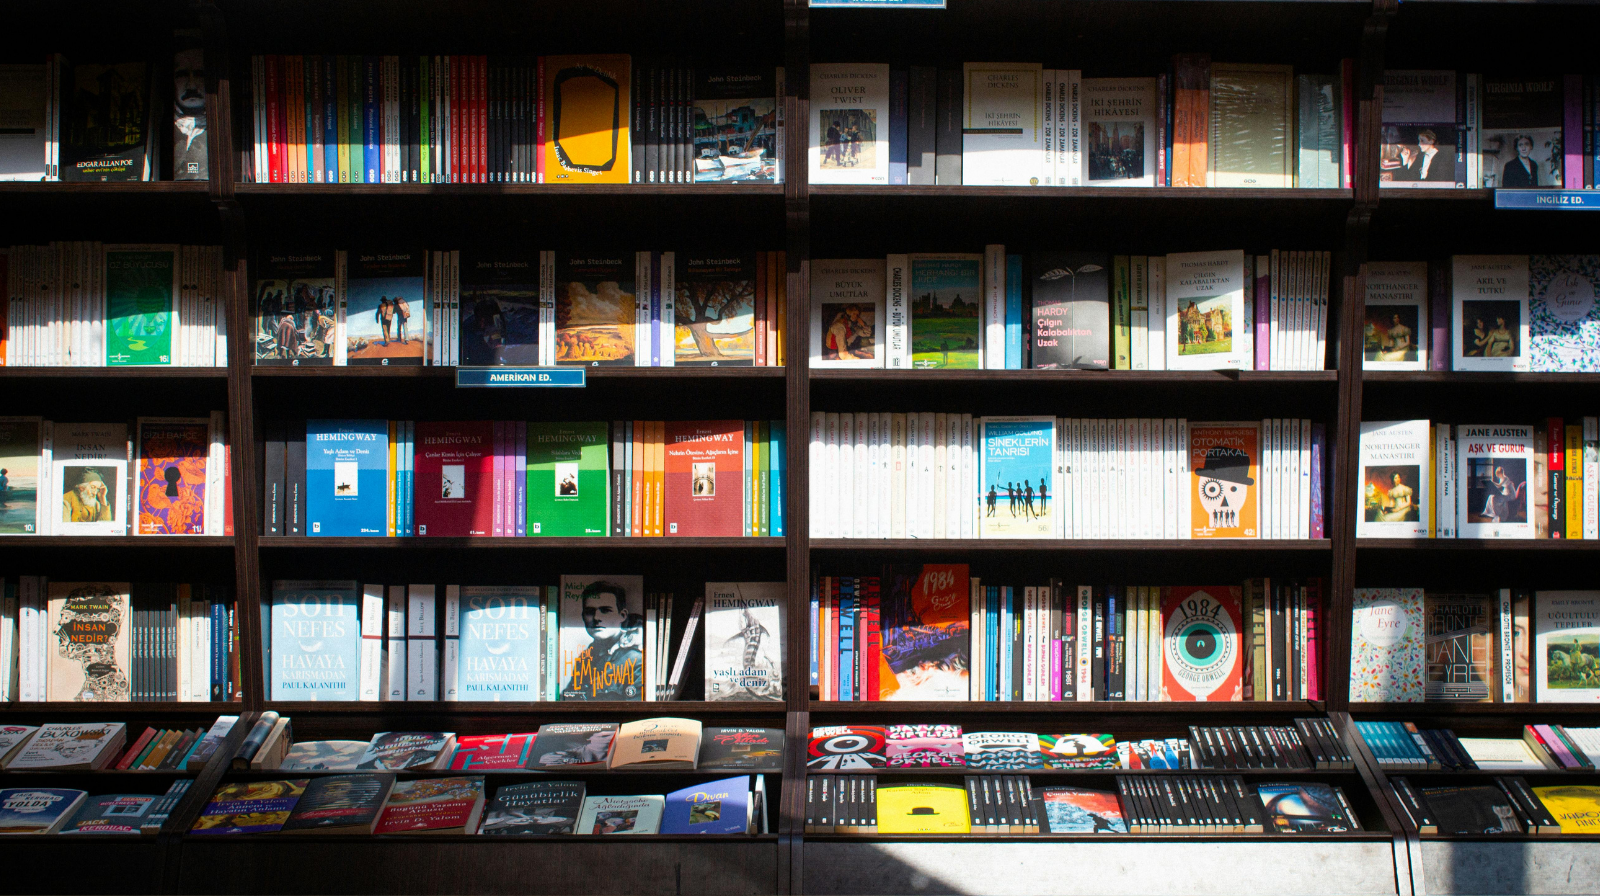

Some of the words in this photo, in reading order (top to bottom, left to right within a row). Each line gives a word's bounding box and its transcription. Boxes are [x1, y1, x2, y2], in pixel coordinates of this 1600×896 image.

[707, 75, 724, 83] John
[726, 74, 762, 82] Steinbeck
[846, 72, 879, 80] DICKENS
[987, 74, 1019, 82] CHARLES
[830, 86, 867, 95] OLIVER
[987, 81, 1020, 90] DICKENS
[1485, 81, 1524, 94] VIRGINIA
[1525, 81, 1555, 93] WOOLF
[832, 95, 864, 105] TWIST
[1091, 98, 1105, 107] İKİ
[1106, 97, 1142, 108] ŞEHRİN
[1536, 195, 1570, 204] İNGİLİZ
[1570, 195, 1586, 204] ED.
[287, 254, 322, 262] Steinbeck
[377, 254, 411, 262] Steinbeck
[569, 258, 586, 266] John
[587, 258, 623, 266] Steinbeck
[688, 258, 705, 266] John
[706, 257, 741, 266] Steinbeck
[1180, 262, 1206, 270] THOMAS
[914, 276, 938, 284] JUDE
[1193, 270, 1217, 280] ÇILGIN
[835, 279, 863, 289] BÜYÜK
[1178, 276, 1231, 287] KALABALIKTAN
[1476, 276, 1494, 286] AKIL
[1495, 276, 1507, 286] VE
[1195, 284, 1215, 293] UZAK
[1477, 286, 1506, 296] TUTKU
[829, 289, 869, 299] UMUTLAR
[1369, 292, 1414, 301] MANASTIRI
[1037, 299, 1061, 307] THOMAS
[1037, 307, 1069, 317] HARDY
[1037, 317, 1063, 329] Çılgın
[1037, 327, 1092, 338] Kalabalıktan
[1037, 338, 1059, 348] Uzak
[489, 373, 538, 382] AMERİKAN
[538, 372, 553, 382] ED.
[142, 430, 167, 440] GİZLİ
[167, 431, 199, 441] BAHÇE
[315, 433, 378, 442] HEMINGWAY
[674, 433, 735, 443] HEMINGWAY
[1371, 429, 1388, 438] JANE
[1388, 429, 1414, 437] AUSTEN
[1465, 428, 1491, 438] JANE
[1491, 428, 1528, 438] AUSTEN
[424, 435, 484, 445] HEMINGWAY
[536, 434, 598, 443] HEMINGWAY
[987, 436, 1049, 447] SİNEKLERİN
[1192, 436, 1246, 447] OTOMATİK
[75, 442, 106, 451] İNSAN
[1364, 441, 1421, 451] NORTHANGER
[1467, 444, 1485, 457] AŞK
[1486, 443, 1497, 454] VE
[1497, 442, 1526, 454] GURUR
[987, 446, 1030, 457] TANRISI
[1192, 447, 1250, 458] PORTAKAL
[1369, 451, 1415, 461] MANASTIRI
[1586, 463, 1595, 481] AŞK
[1587, 481, 1595, 493] VE
[1587, 493, 1595, 525] GURUR
[922, 569, 955, 596] 1984
[713, 591, 736, 599] Ernest
[853, 577, 861, 613] ORWELL
[70, 603, 87, 611] MARK
[88, 603, 110, 611] TWAIN
[713, 598, 777, 609] HEMINGWAY
[867, 578, 880, 648] ORWELL
[1178, 598, 1223, 620] 1984
[1369, 604, 1394, 618] Jane
[1427, 603, 1487, 616] CHARLOTTE
[840, 578, 853, 656] ORWELL
[1547, 609, 1600, 620] UĞULTULU
[73, 621, 107, 633] İNSAN
[282, 620, 346, 638] NEFES
[1377, 617, 1401, 632] Eyre
[1553, 620, 1594, 630] TEPELER
[466, 622, 530, 641] NEFES
[70, 632, 109, 644] NEDİR?
[1427, 633, 1487, 664] JANE
[282, 654, 347, 669] HAVAYA
[466, 656, 529, 671] HAVAYA
[282, 669, 347, 684] KARIŞMADAN
[563, 647, 637, 698] HEMINGWAY
[713, 667, 736, 681] yaşlı
[737, 666, 768, 677] adam
[1065, 669, 1073, 686] 1984
[1177, 668, 1201, 683] GEORGE
[1201, 667, 1227, 683] ORWELL
[1427, 664, 1487, 684] EYRE
[466, 671, 529, 686] KARIŞMADAN
[282, 681, 303, 690] PAUL
[302, 681, 347, 690] KALANITHI
[466, 684, 486, 692] PAUL
[486, 683, 530, 692] KALANITHI
[39, 728, 112, 740] BUKOWSKI
[889, 724, 958, 734] HAYVAN
[967, 733, 1031, 741] GEORGE
[967, 738, 1031, 746] ORWELL
[891, 750, 959, 759] GEORGE
[890, 756, 963, 766] ORWELL
[497, 790, 579, 802] Günübirlik
[685, 791, 730, 803] Divan
[8, 800, 48, 808] YOLDA
[504, 797, 569, 807] Hayatlar
